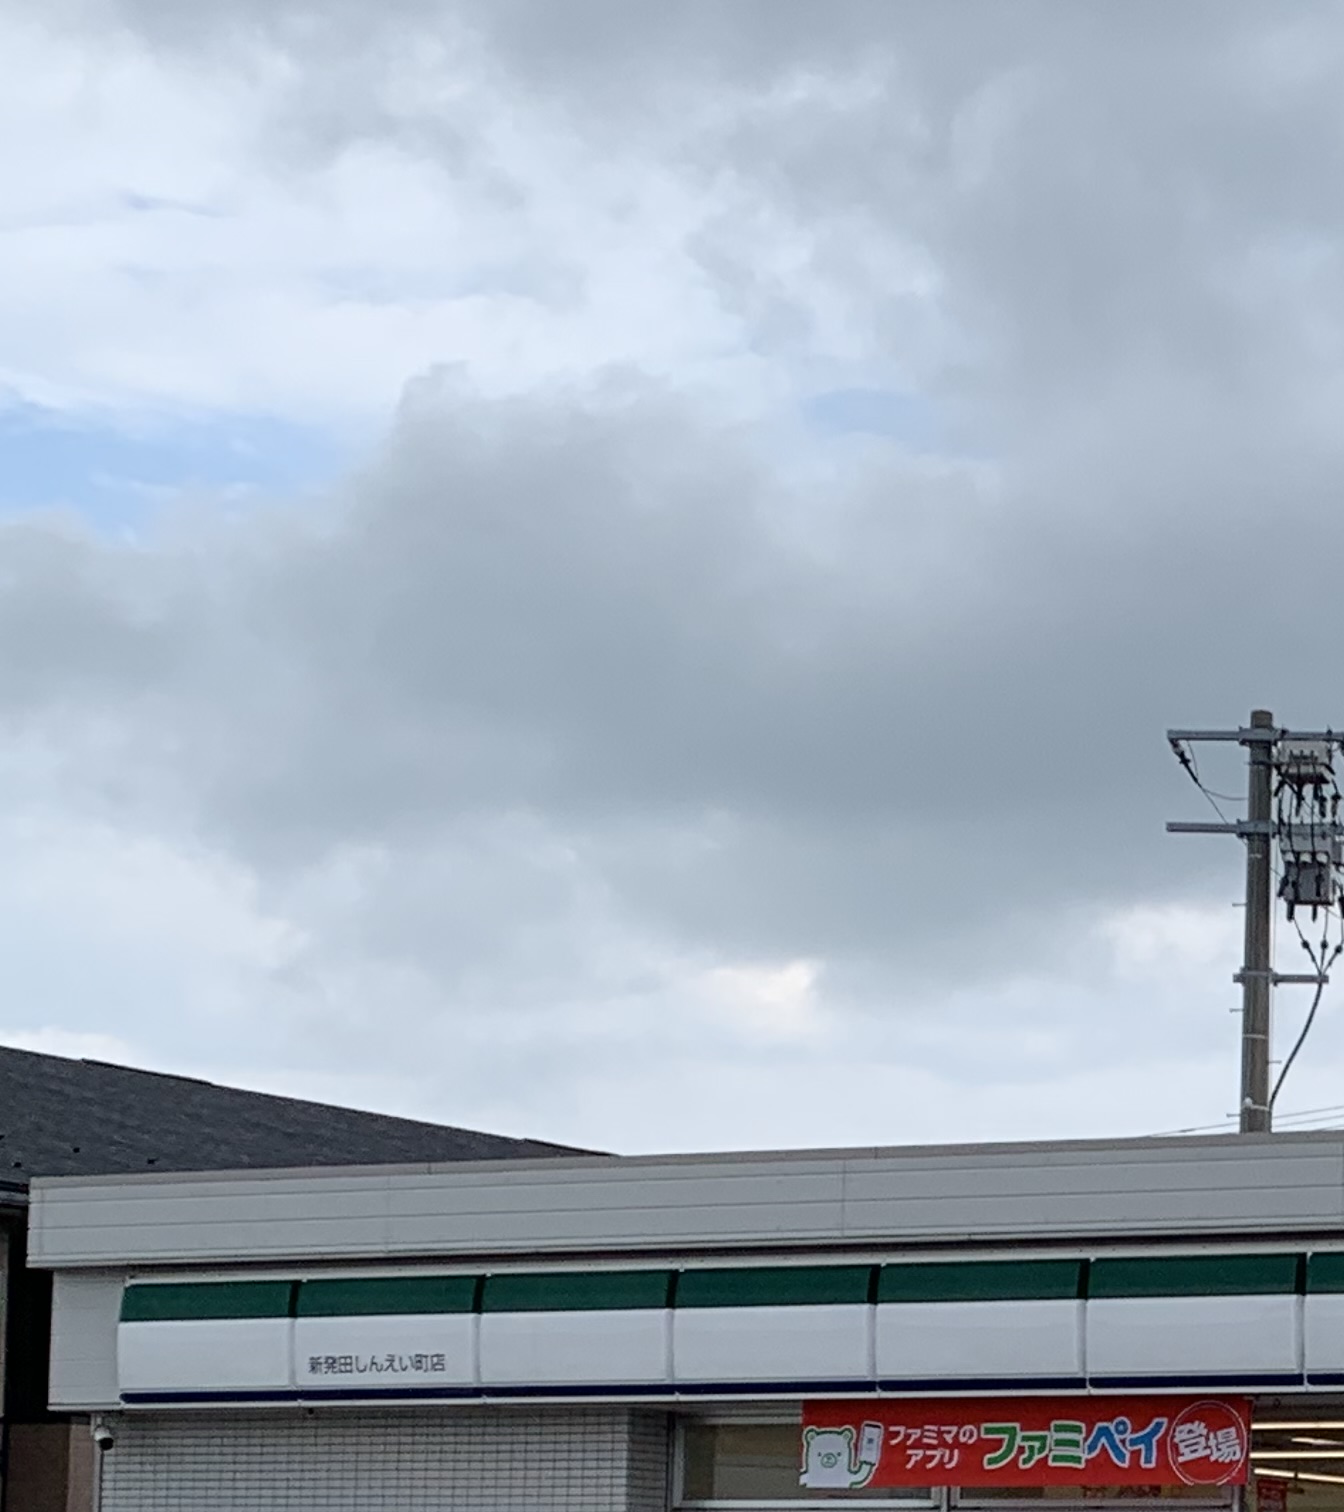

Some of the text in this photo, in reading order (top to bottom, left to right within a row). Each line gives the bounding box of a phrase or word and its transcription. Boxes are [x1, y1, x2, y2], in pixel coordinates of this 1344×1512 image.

[308, 1354, 446, 1374] 新発田しんえい町店
[888, 1424, 975, 1446] ファミマの
[981, 1417, 1168, 1470] ファミペイ
[1173, 1421, 1243, 1463] 登場
[905, 1449, 959, 1470] アプリ
